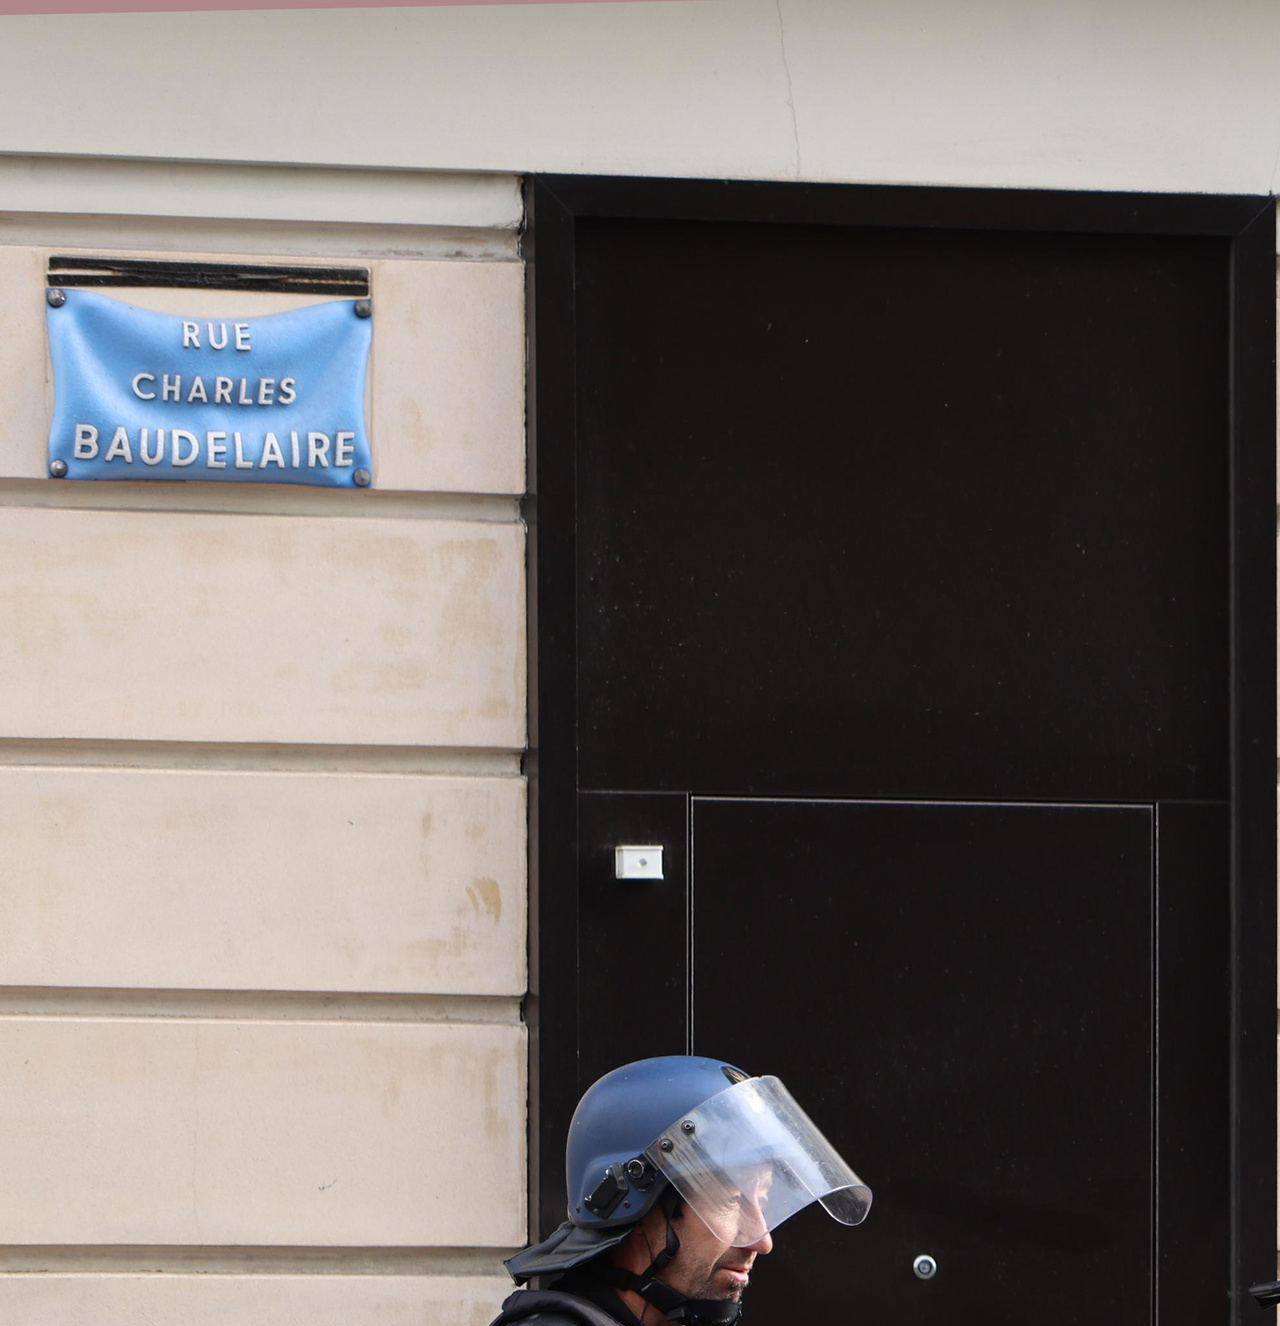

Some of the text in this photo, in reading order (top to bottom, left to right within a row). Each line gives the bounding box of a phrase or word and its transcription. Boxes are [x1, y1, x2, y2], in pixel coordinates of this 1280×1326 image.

[181, 321, 252, 351] RUE
[131, 372, 297, 406] CHARLES
[73, 422, 355, 469] BAUDELAIRE
